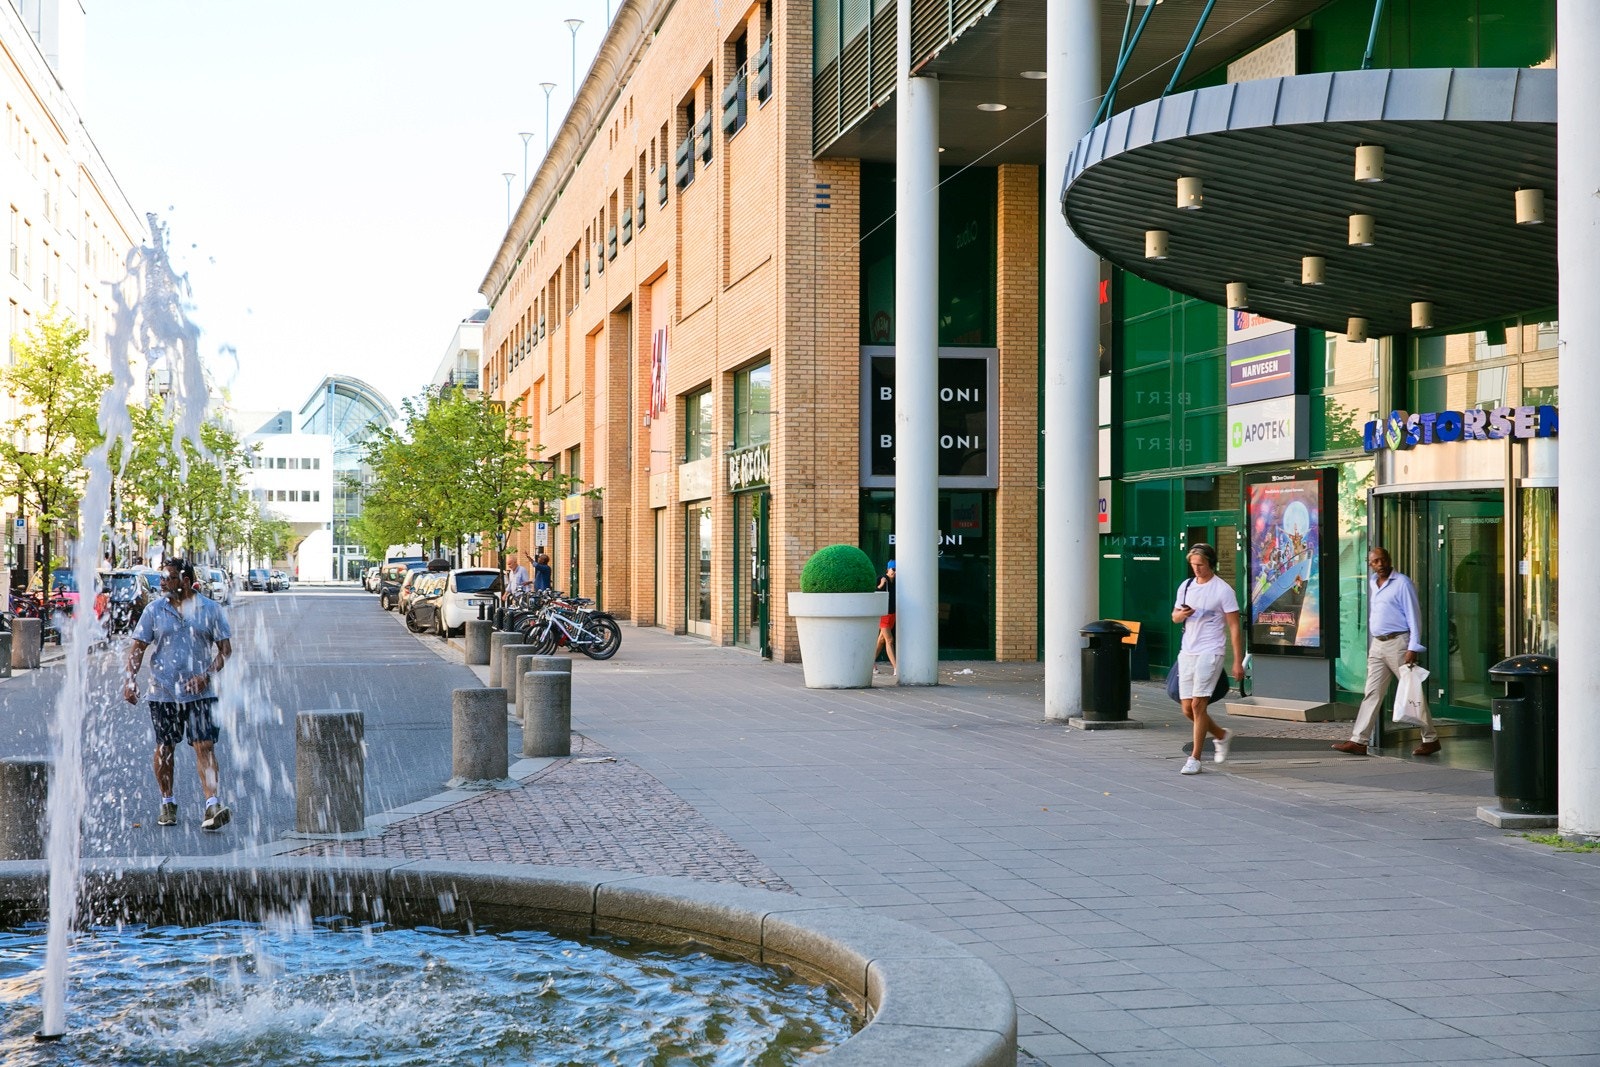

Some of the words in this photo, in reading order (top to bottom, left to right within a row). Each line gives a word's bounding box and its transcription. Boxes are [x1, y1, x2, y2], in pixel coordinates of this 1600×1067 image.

[1242, 360, 1279, 378] NARVESEN
[880, 386, 979, 401] BONI
[880, 434, 979, 449] BONI
